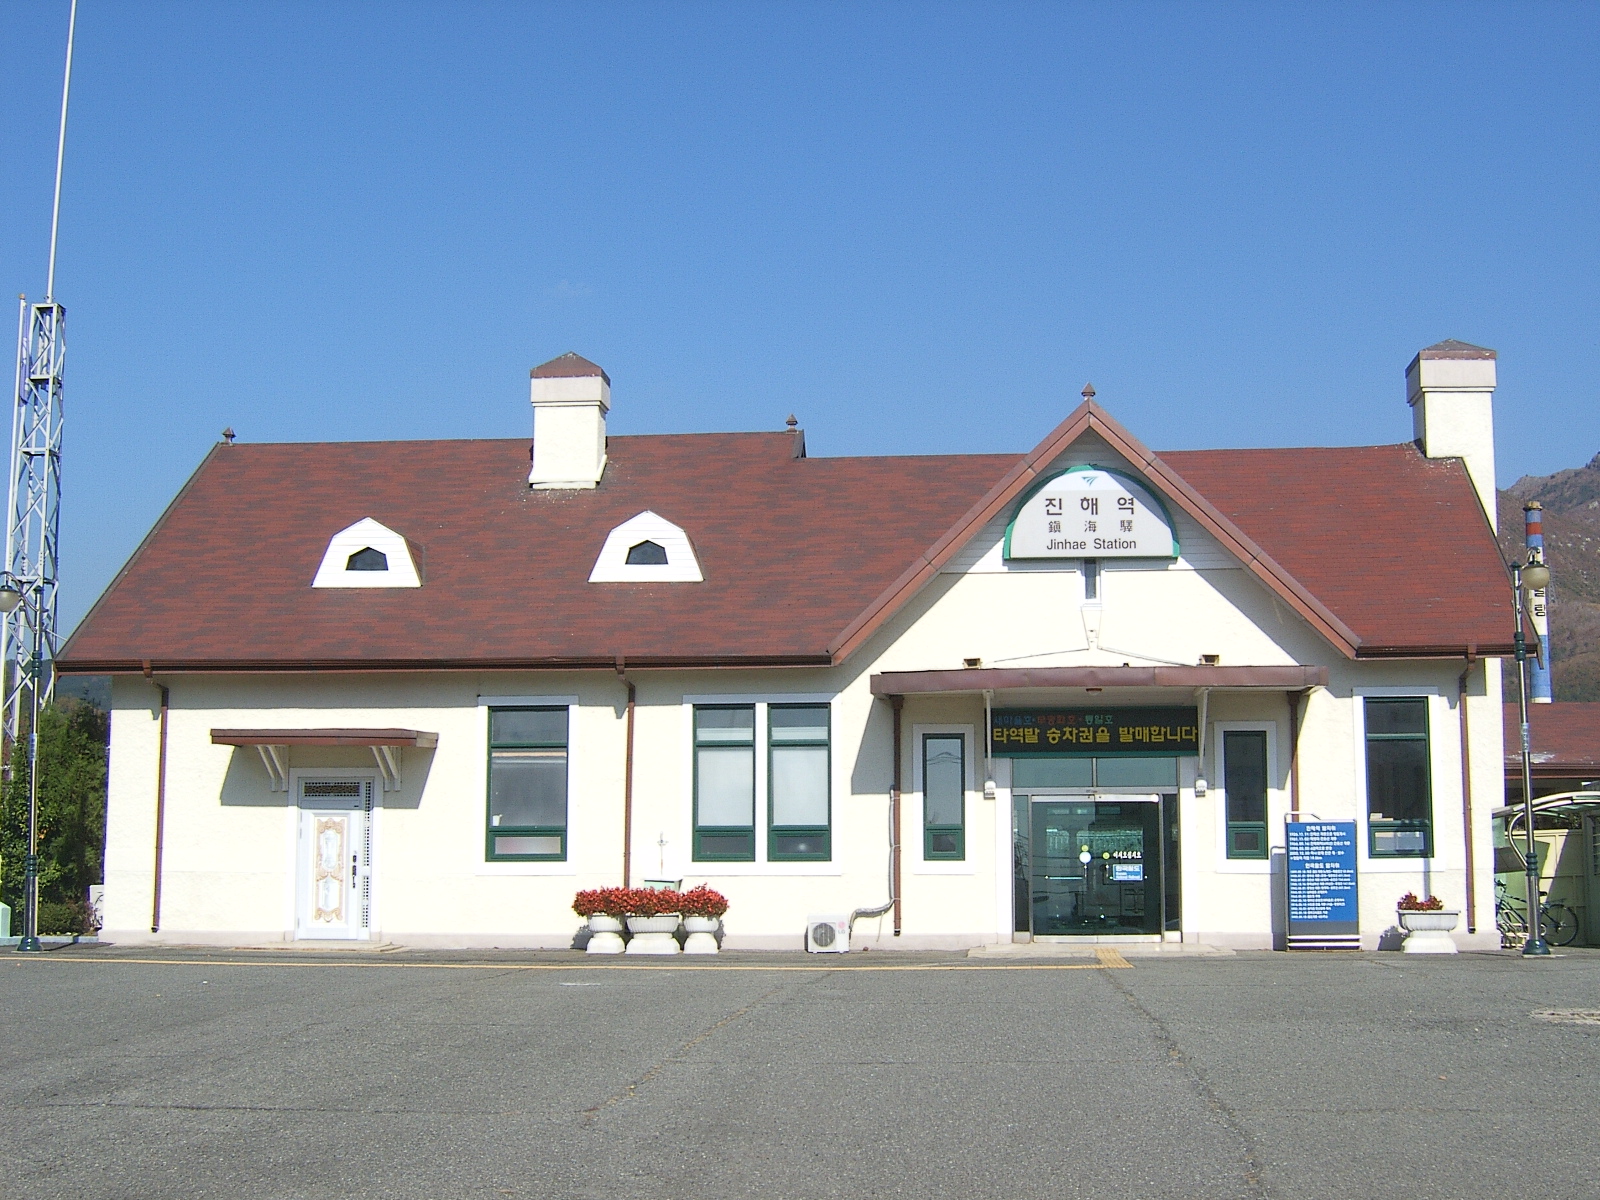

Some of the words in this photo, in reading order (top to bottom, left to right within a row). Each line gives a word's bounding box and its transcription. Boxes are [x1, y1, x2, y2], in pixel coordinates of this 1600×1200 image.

[1046, 538, 1087, 550] Jinhae
[1093, 537, 1137, 550] Station
[993, 727, 1040, 743] 타역발
[1046, 726, 1111, 744] 승차권을
[1118, 725, 1197, 743] 발매합니다
